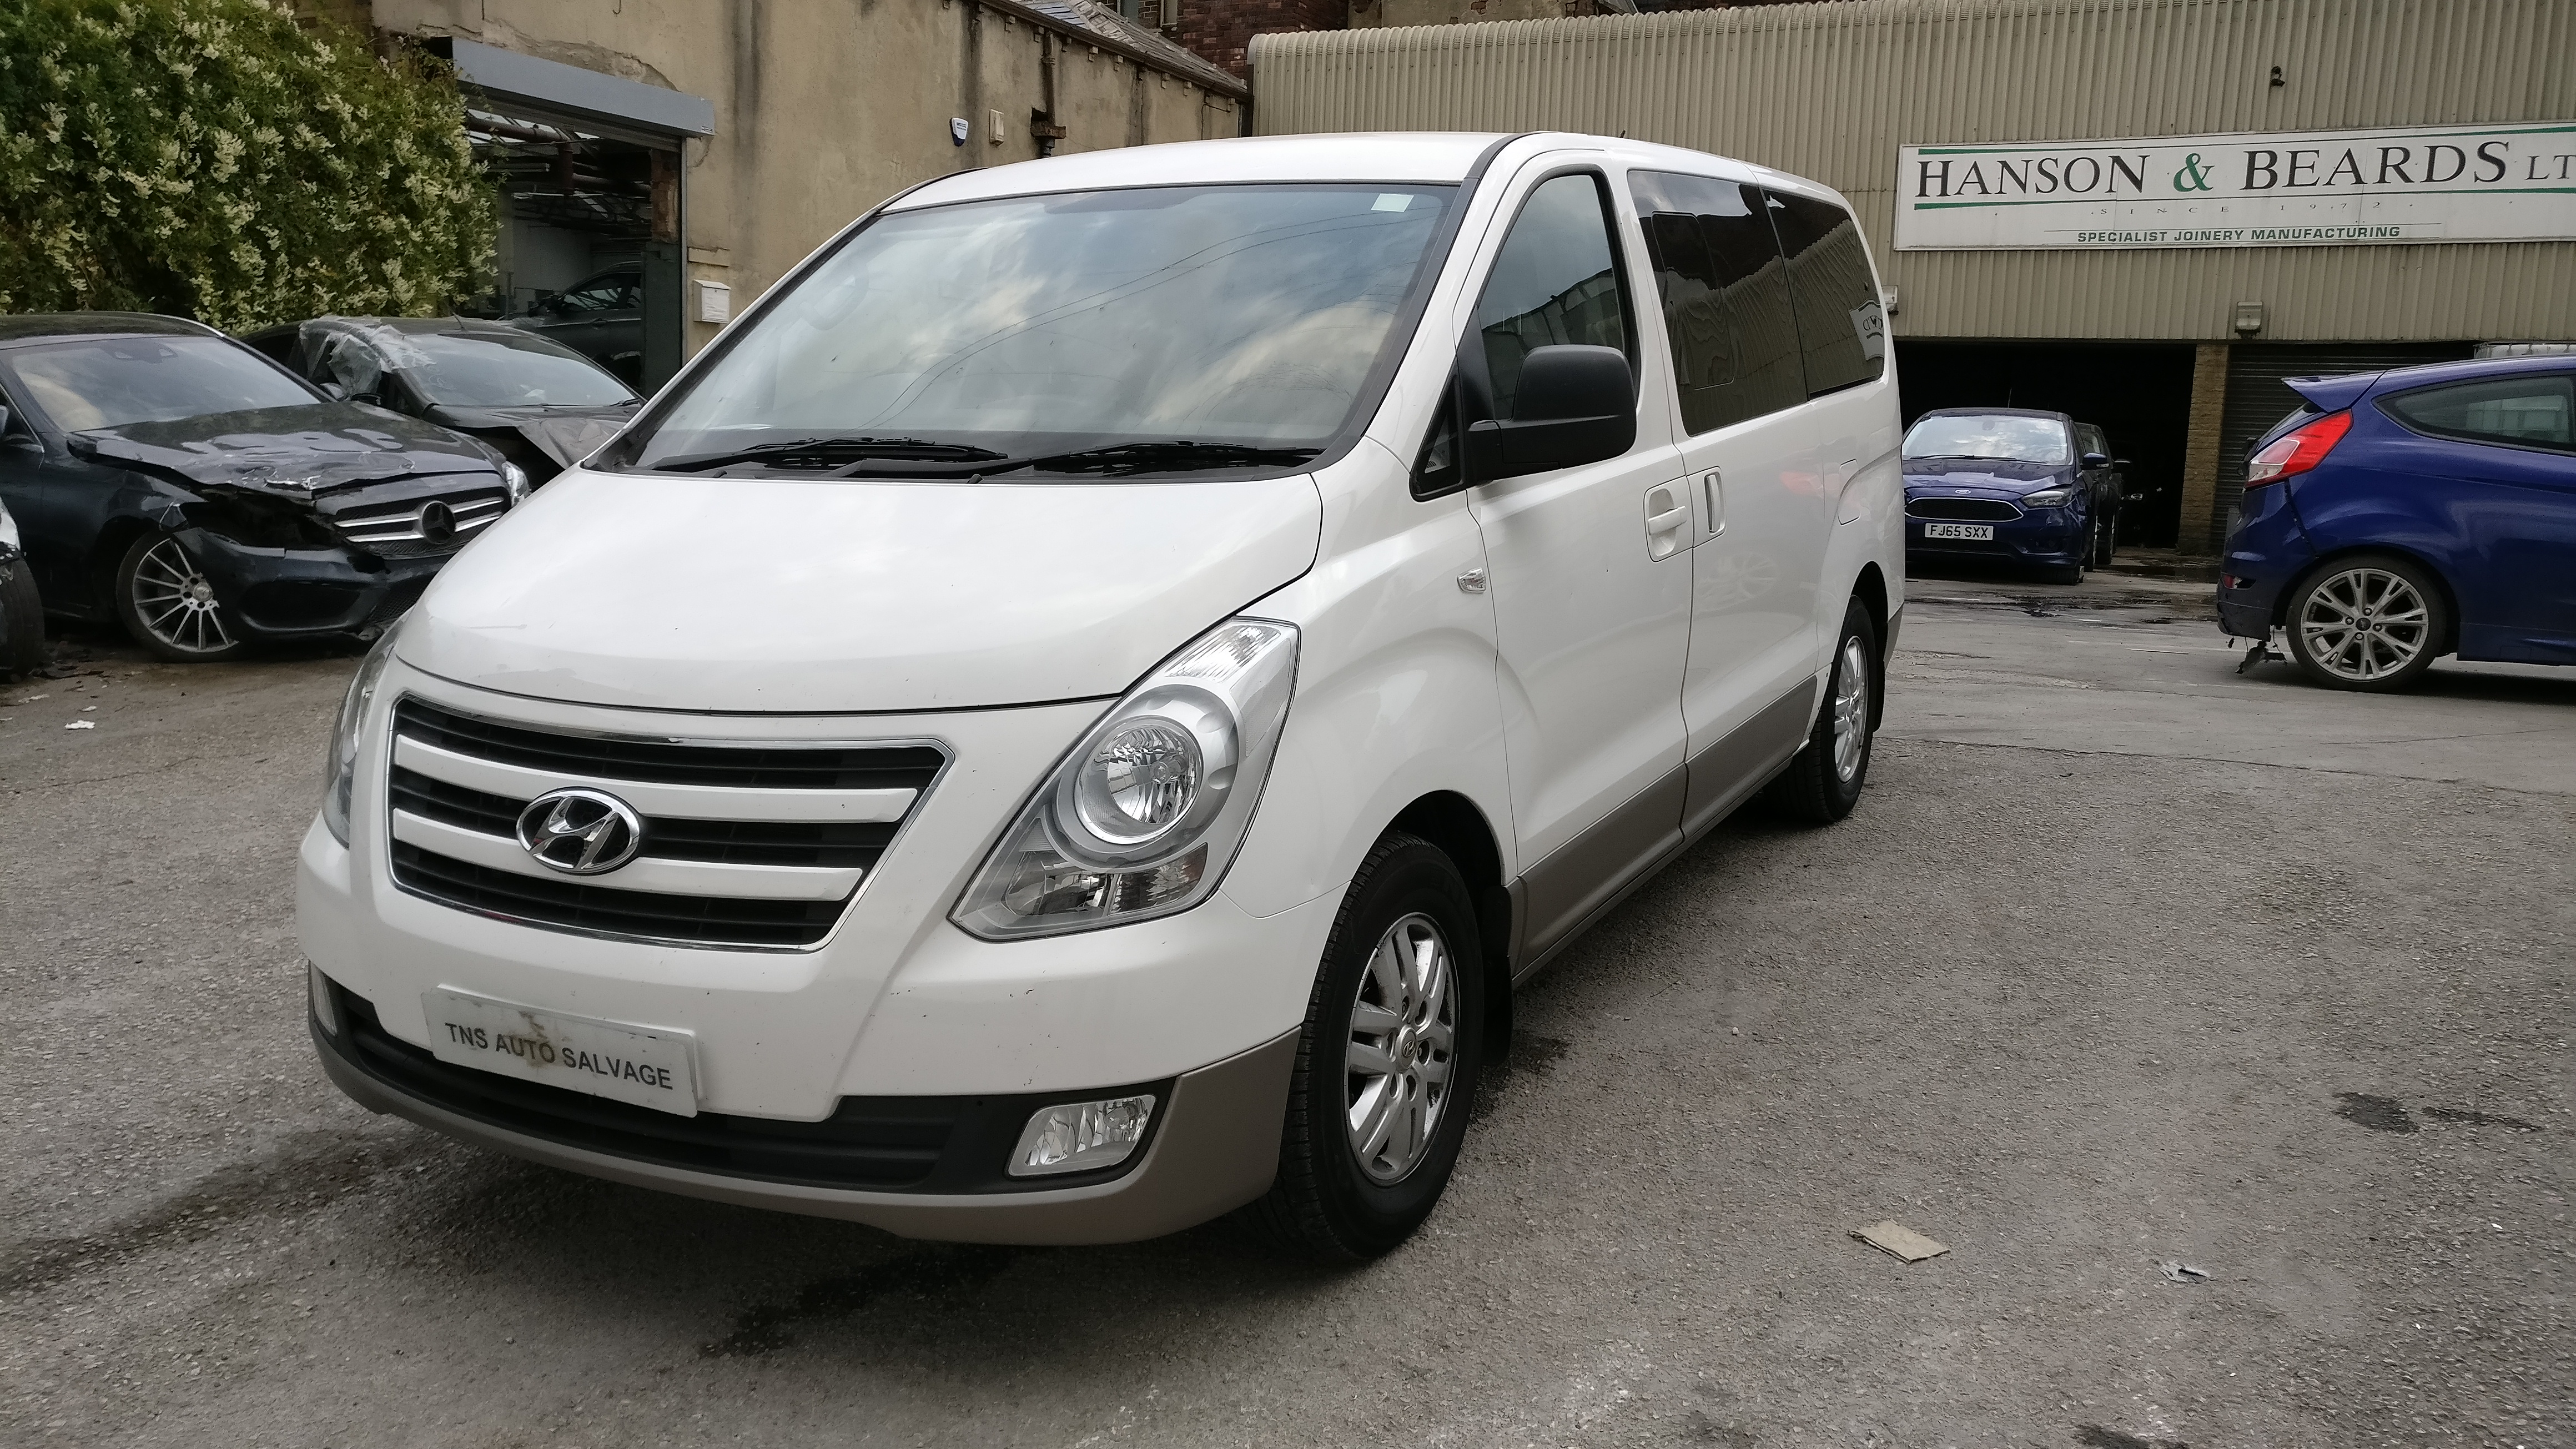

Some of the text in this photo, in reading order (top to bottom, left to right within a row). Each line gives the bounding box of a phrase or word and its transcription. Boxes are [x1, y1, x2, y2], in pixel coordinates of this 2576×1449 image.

[1915, 155, 2150, 198] HANSON
[2173, 153, 2215, 193] &
[2238, 140, 2510, 191] BEARDS
[2077, 226, 2401, 243] SPECIALIST JOINERY MANUFACTURING
[1930, 525, 1989, 539] FJ65 SXX
[444, 1022, 674, 1090] TNS AUTO SALVAGE
